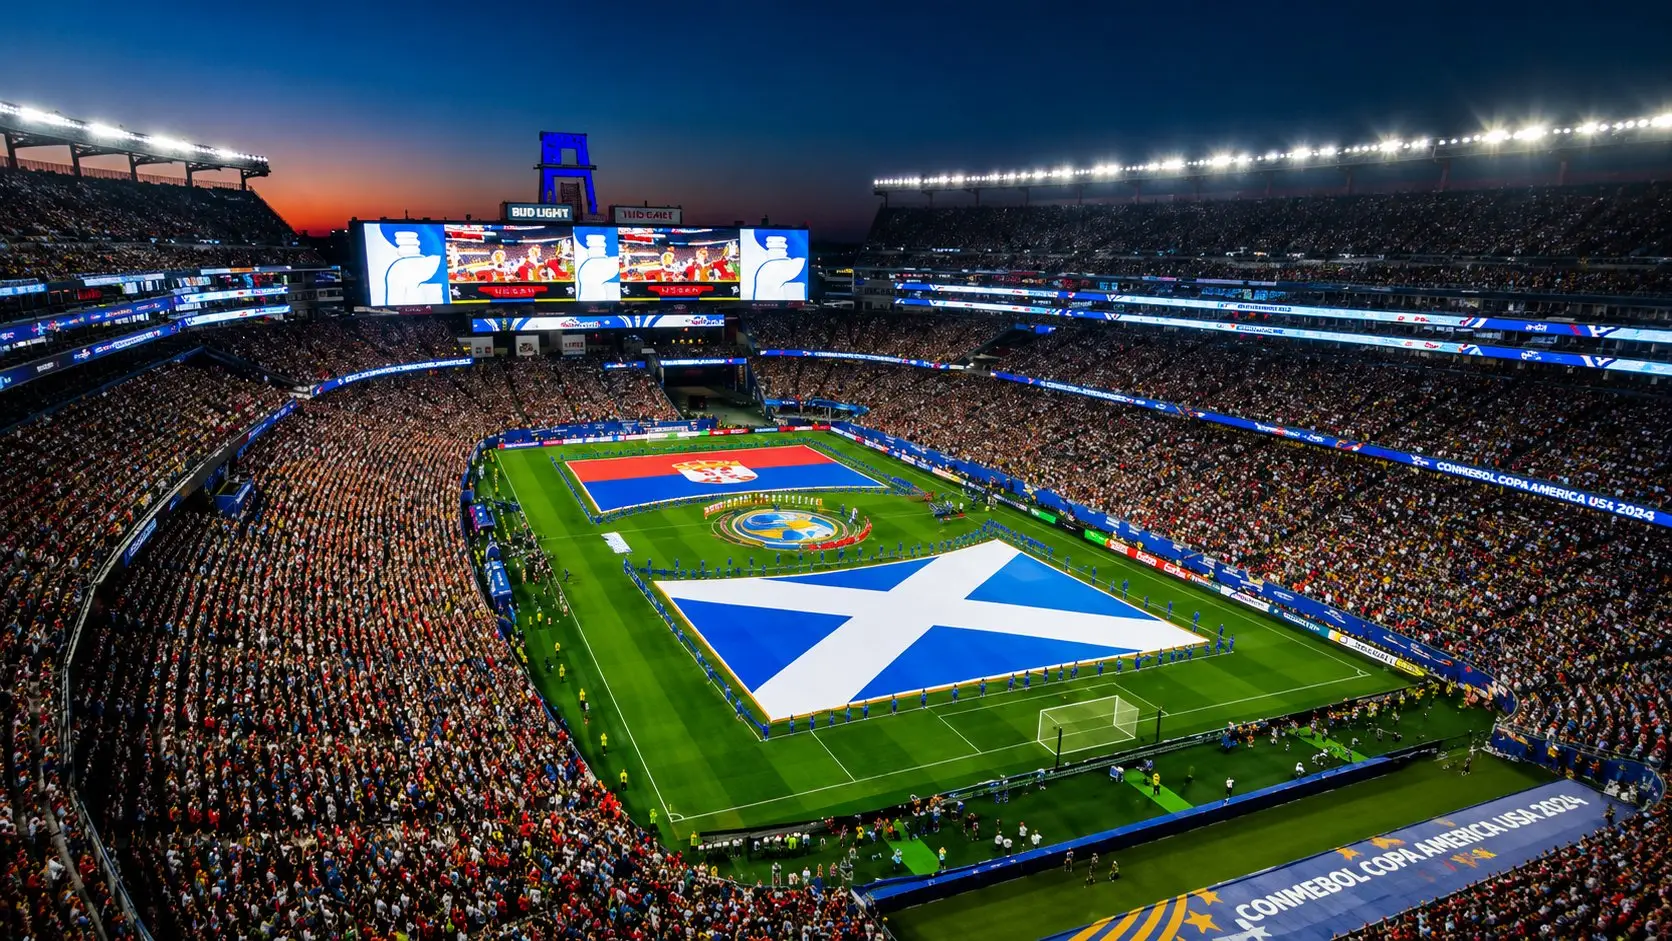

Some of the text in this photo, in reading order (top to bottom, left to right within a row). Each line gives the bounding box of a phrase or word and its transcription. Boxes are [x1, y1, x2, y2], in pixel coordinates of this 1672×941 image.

[512, 207, 568, 218] BUD LIGHT
[1498, 475, 1528, 490] COPA
[1530, 483, 1586, 504] AMERICA
[1616, 503, 1655, 522] 2024
[1236, 794, 1589, 922] CONMEBOL COPA AMERICA USA 2024
